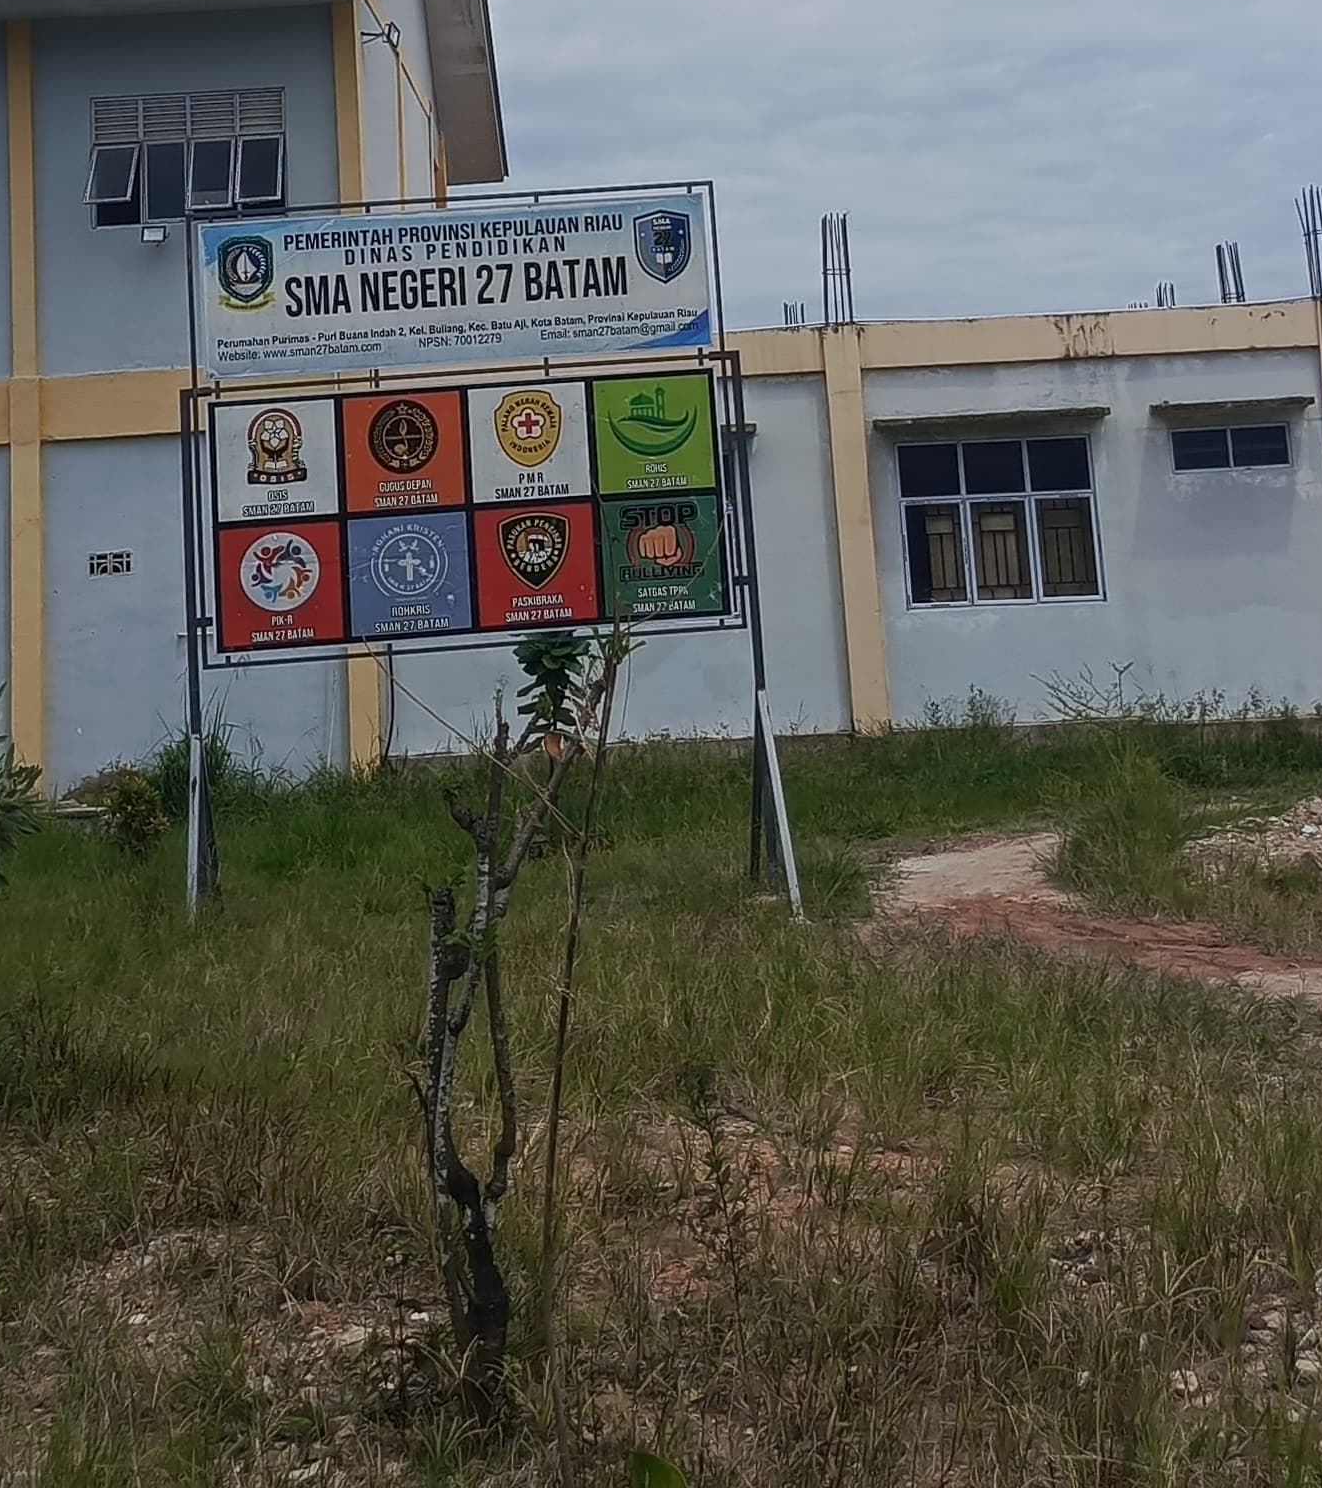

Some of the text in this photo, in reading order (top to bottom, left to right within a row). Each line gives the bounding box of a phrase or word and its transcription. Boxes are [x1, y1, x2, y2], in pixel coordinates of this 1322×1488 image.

[284, 214, 623, 251] PEMERINTAH PROVINSI KEPULAUAN RIAU
[345, 236, 566, 265] DINAS PENDIDIKAN
[285, 256, 628, 317] SMA NEGERI 27 BATAM
[217, 338, 269, 349] Perumahan
[272, 335, 310, 345] Purimas
[318, 332, 337, 342] Puri
[340, 331, 369, 341] Buana
[371, 328, 396, 338] Indah
[399, 328, 407, 338] 2,
[409, 326, 427, 335] Kel.
[429, 324, 467, 336] Buliang,
[468, 322, 488, 332] Kec.
[491, 320, 512, 330] Batu
[531, 318, 552, 328] Kota
[554, 316, 586, 327] Batam,
[588, 313, 625, 324] Provinsi
[628, 310, 675, 324] Kepulauan
[677, 308, 697, 318] Riau
[541, 321, 699, 340] Email: sman27batam@gmail.com
[419, 332, 502, 348] NPSN: 70012279
[218, 343, 382, 362] Website: www.sman27batam.com
[645, 463, 668, 473] ROHIS
[379, 479, 432, 492] GUGUS DEPAN
[627, 475, 687, 489] SMAN 27 BATAM
[268, 490, 288, 501] OSIS
[495, 484, 569, 500] SMAN 27 BATAM
[374, 493, 438, 508] SMAN 27 BATAM
[243, 501, 314, 517] SMAN 27 BATAM
[620, 503, 698, 531] STOP
[638, 586, 668, 598] SATGAS
[512, 595, 563, 607] PASKIBRAKA
[633, 601, 655, 613] SMAN
[392, 604, 431, 617] ROHKRIS
[505, 608, 572, 622] SMAN 27 BATAM
[375, 618, 449, 633] SMAN 27 BATAM
[252, 627, 314, 642] SMAN 27 BATAM
